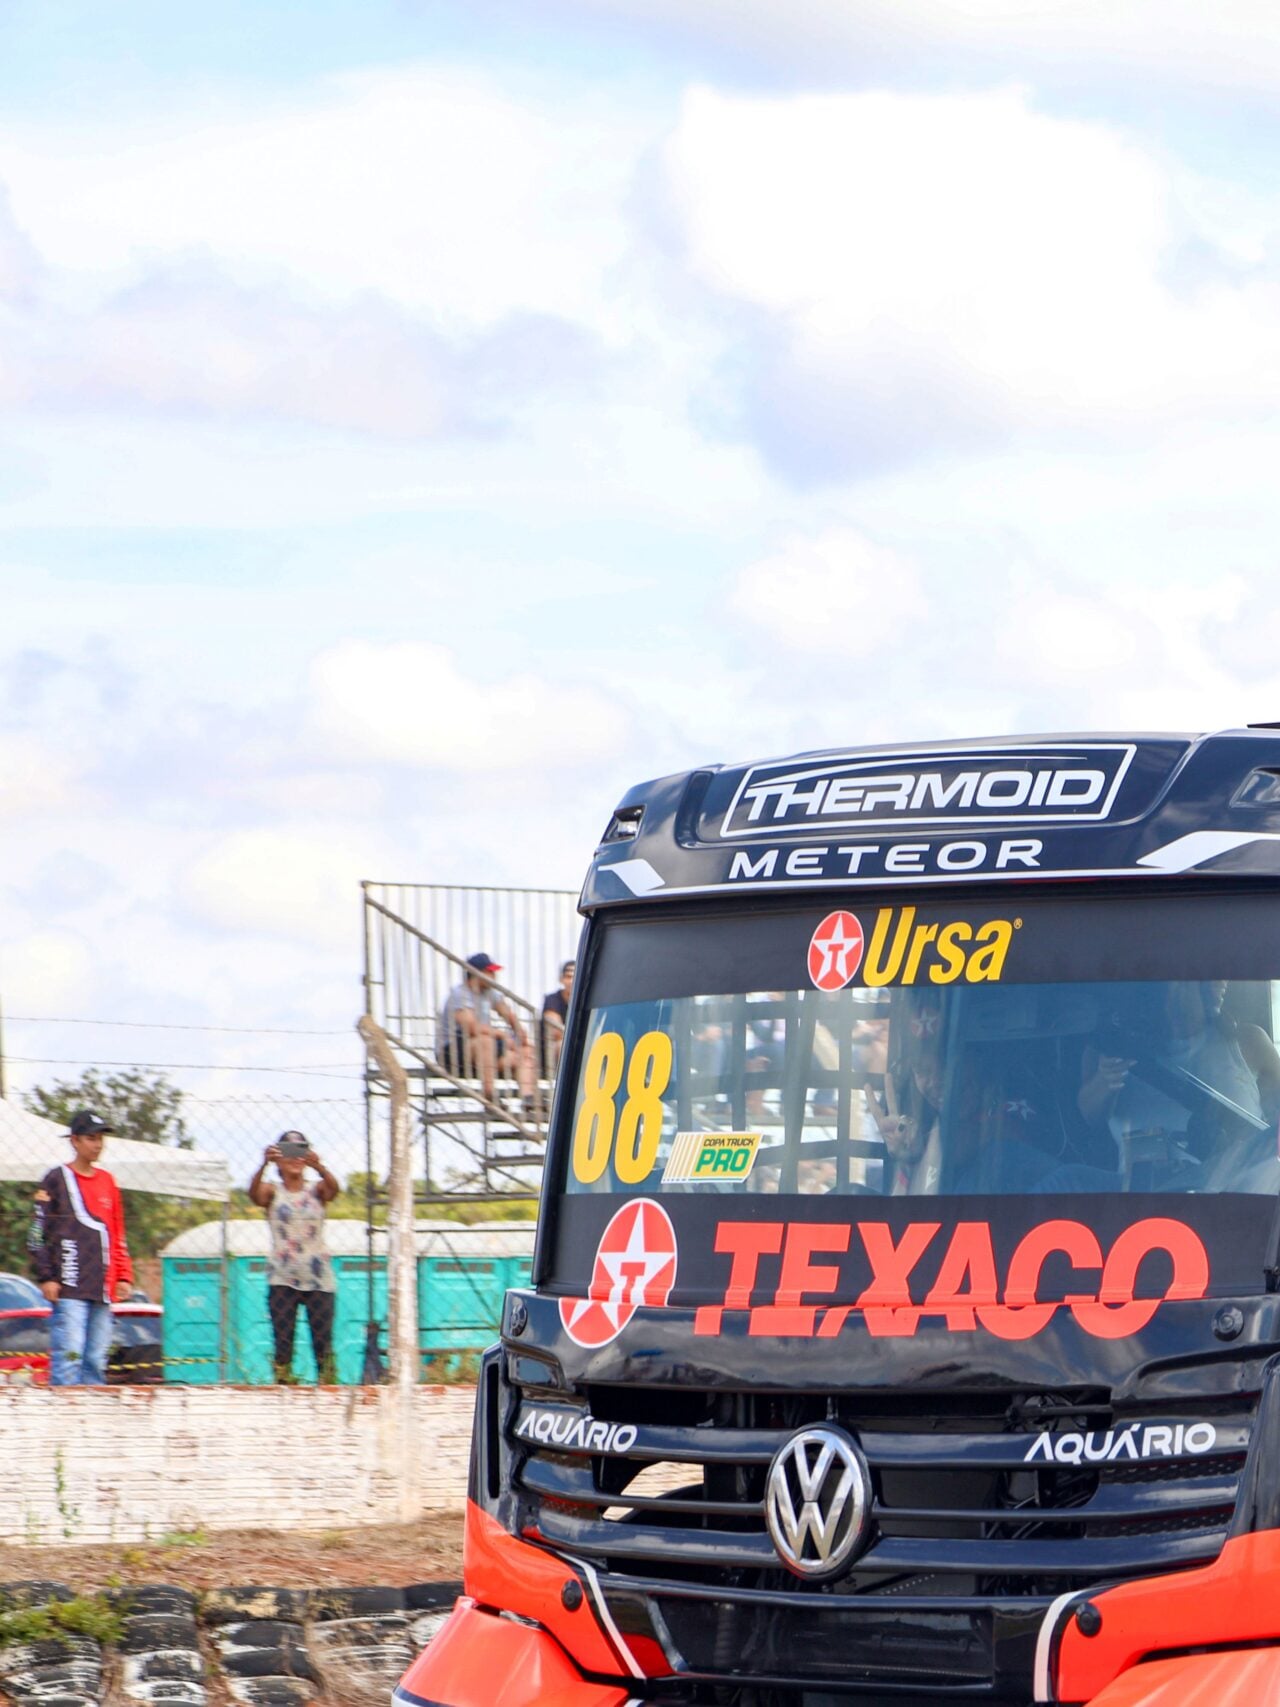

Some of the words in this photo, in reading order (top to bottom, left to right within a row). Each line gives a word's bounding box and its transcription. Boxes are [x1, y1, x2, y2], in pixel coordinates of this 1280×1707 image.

[744, 768, 1106, 822] THERMOID
[729, 839, 1043, 880] METEOR
[572, 1031, 673, 1184] 88
[695, 1148, 751, 1173] PRO
[703, 1138, 725, 1147] COPA
[726, 1137, 756, 1147] TRUCK
[694, 1217, 1210, 1340] TEXACO
[516, 1410, 638, 1453] AQUÁRIO
[1023, 1422, 1217, 1465] AQUÁRIO
